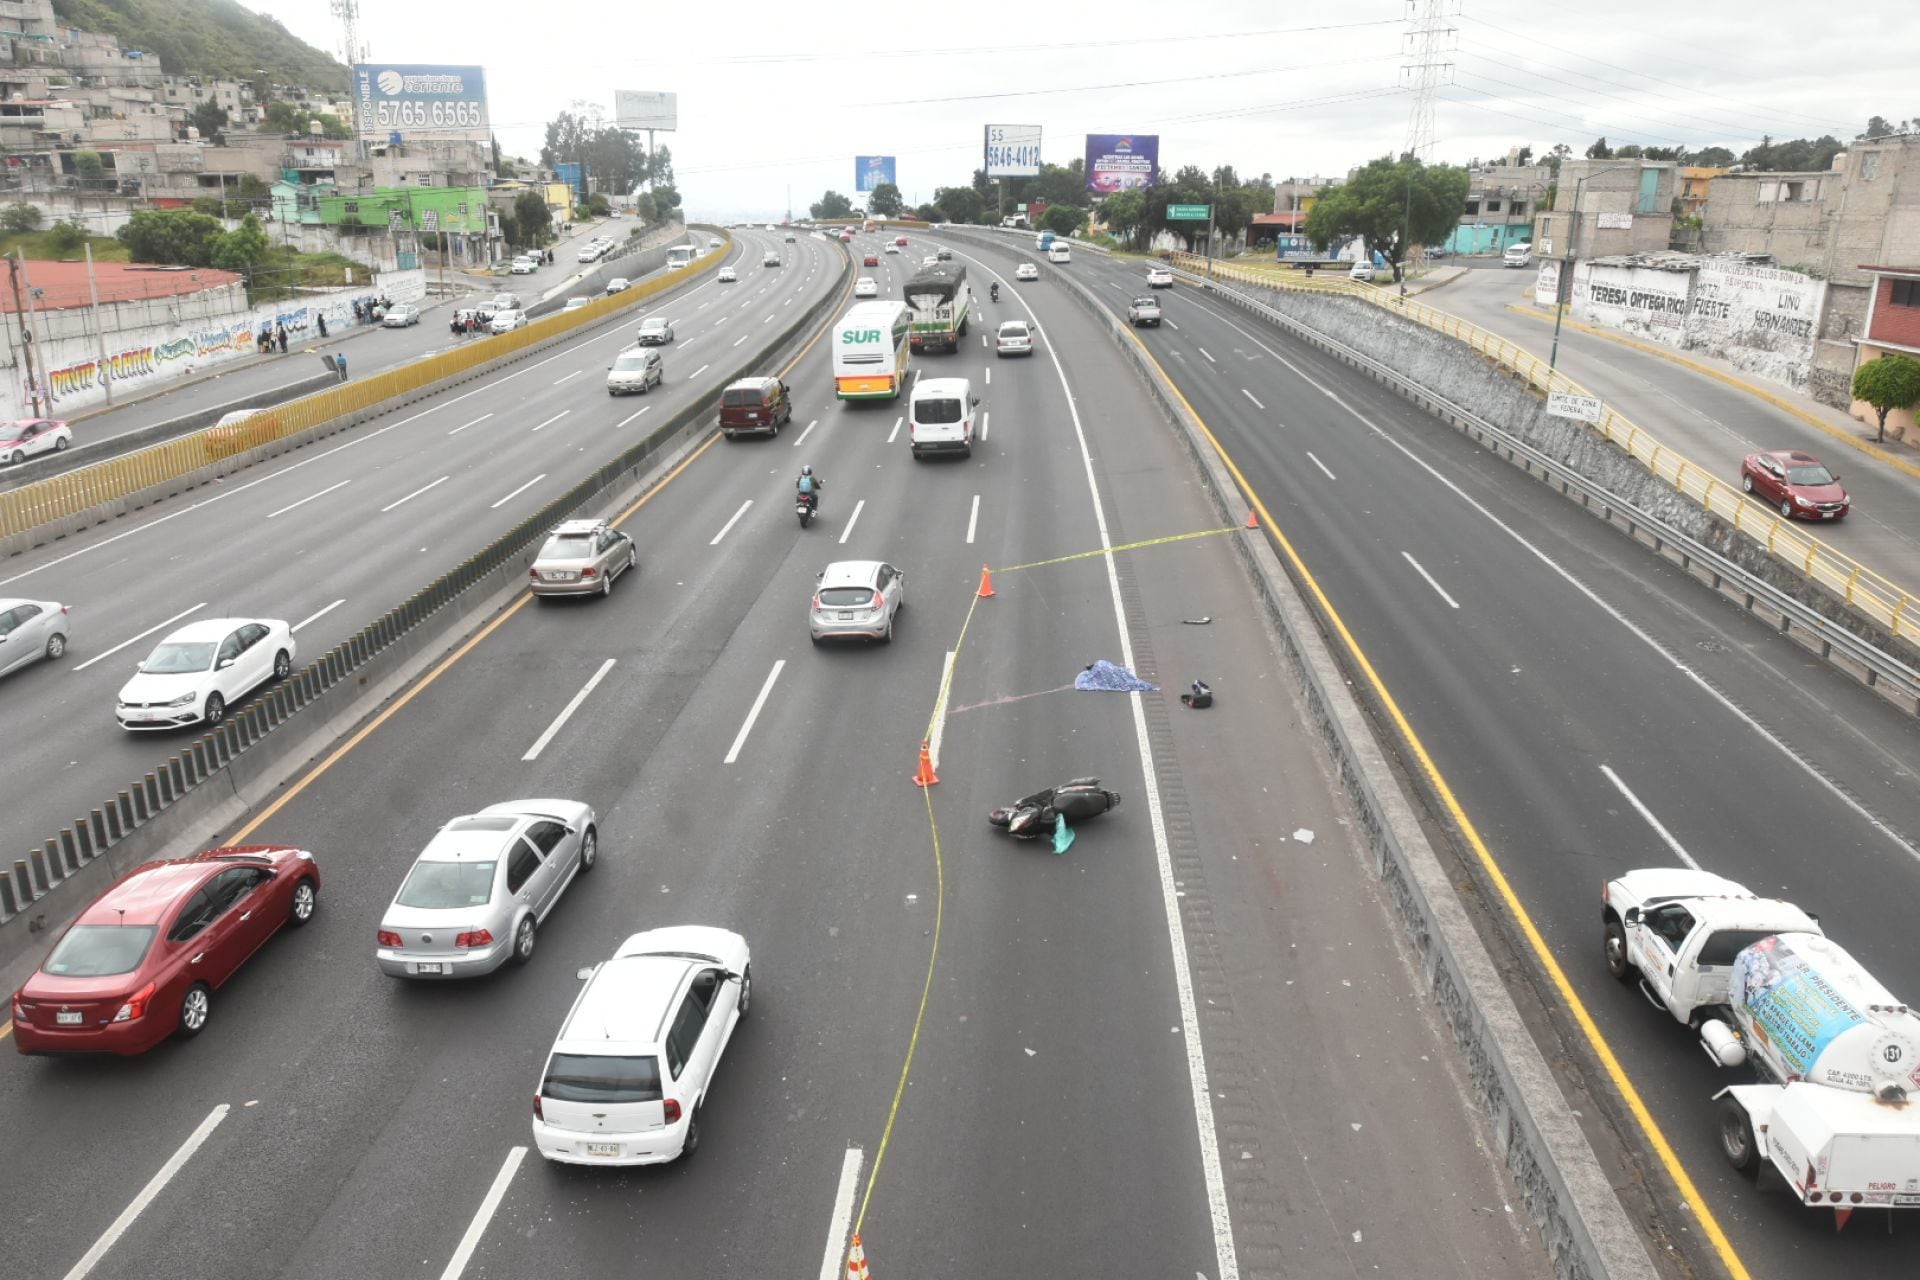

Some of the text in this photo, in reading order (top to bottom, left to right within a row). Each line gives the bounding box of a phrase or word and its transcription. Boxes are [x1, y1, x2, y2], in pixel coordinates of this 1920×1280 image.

[359, 69, 376, 135] DISPONIBLE
[378, 100, 481, 127] 5765 6565
[988, 146, 1039, 167] 5646-4012
[1719, 263, 1754, 277] ENCUESTA
[1755, 268, 1777, 281] ELLOS
[1590, 284, 1627, 306] TERESA
[1630, 291, 1665, 313] ORTEGA
[1666, 297, 1685, 315] RICO
[1693, 297, 1731, 319] FUERTE
[1778, 293, 1801, 311] LINO
[1753, 310, 1812, 338] HERNANDEZ
[841, 329, 881, 345] SUR
[1560, 404, 1584, 415] FEDERAL
[1581, 399, 1597, 408] ZONA
[1796, 962, 1810, 976] SR.
[1809, 975, 1862, 1022] PRESIDENTE
[1783, 1031, 1807, 1058] TRABAJO
[1795, 1032, 1816, 1054] LLAMA
[1885, 1048, 1900, 1060] 131
[1868, 1182, 1896, 1191] PELIGRO
